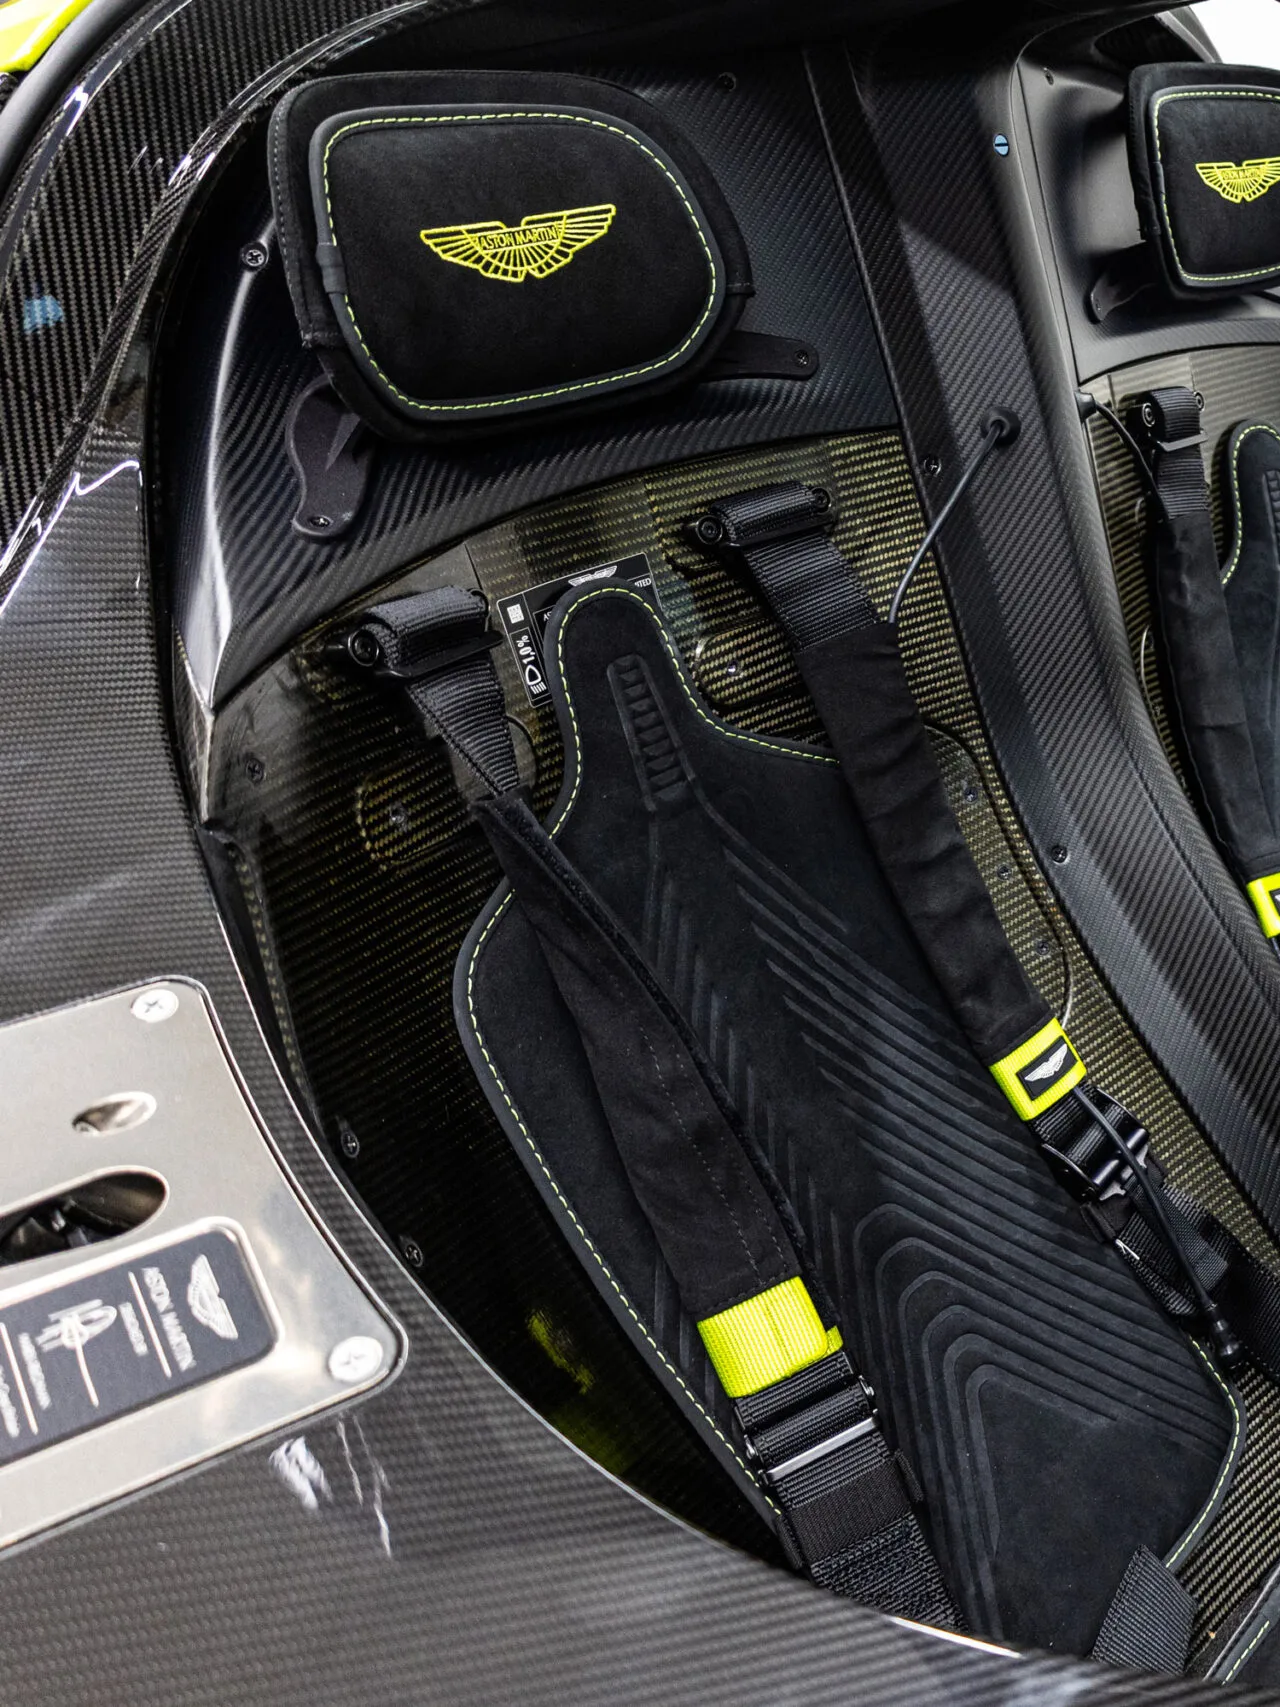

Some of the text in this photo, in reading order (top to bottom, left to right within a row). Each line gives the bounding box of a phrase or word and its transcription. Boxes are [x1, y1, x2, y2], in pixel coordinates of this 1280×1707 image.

[480, 226, 558, 250] ASTON MARTIN
[141, 1266, 197, 1372] ASTON MARTIN
